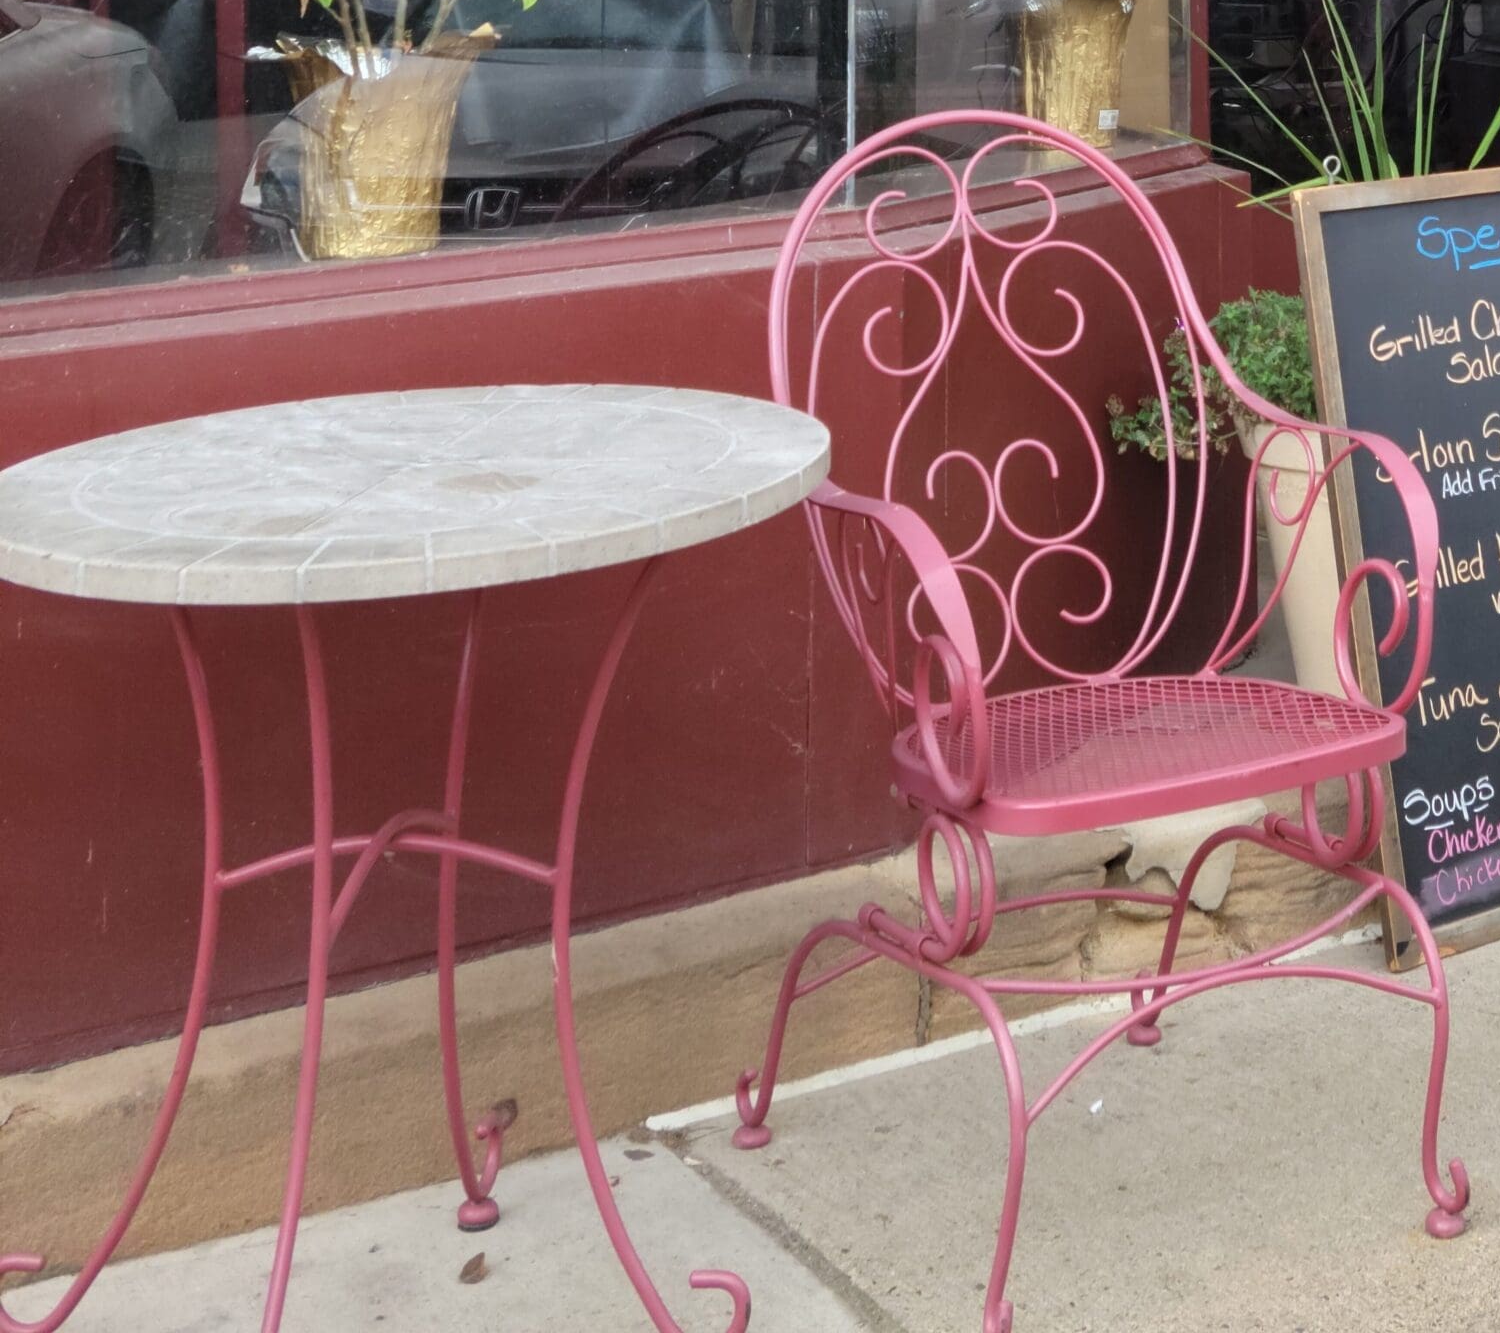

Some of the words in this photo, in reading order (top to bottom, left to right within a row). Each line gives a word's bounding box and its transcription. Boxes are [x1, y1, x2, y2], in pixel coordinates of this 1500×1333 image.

[1369, 313, 1461, 362] Grilled
[1442, 469, 1474, 500] Add
[1416, 677, 1488, 727] Tuna
[1403, 775, 1495, 821] Soups
